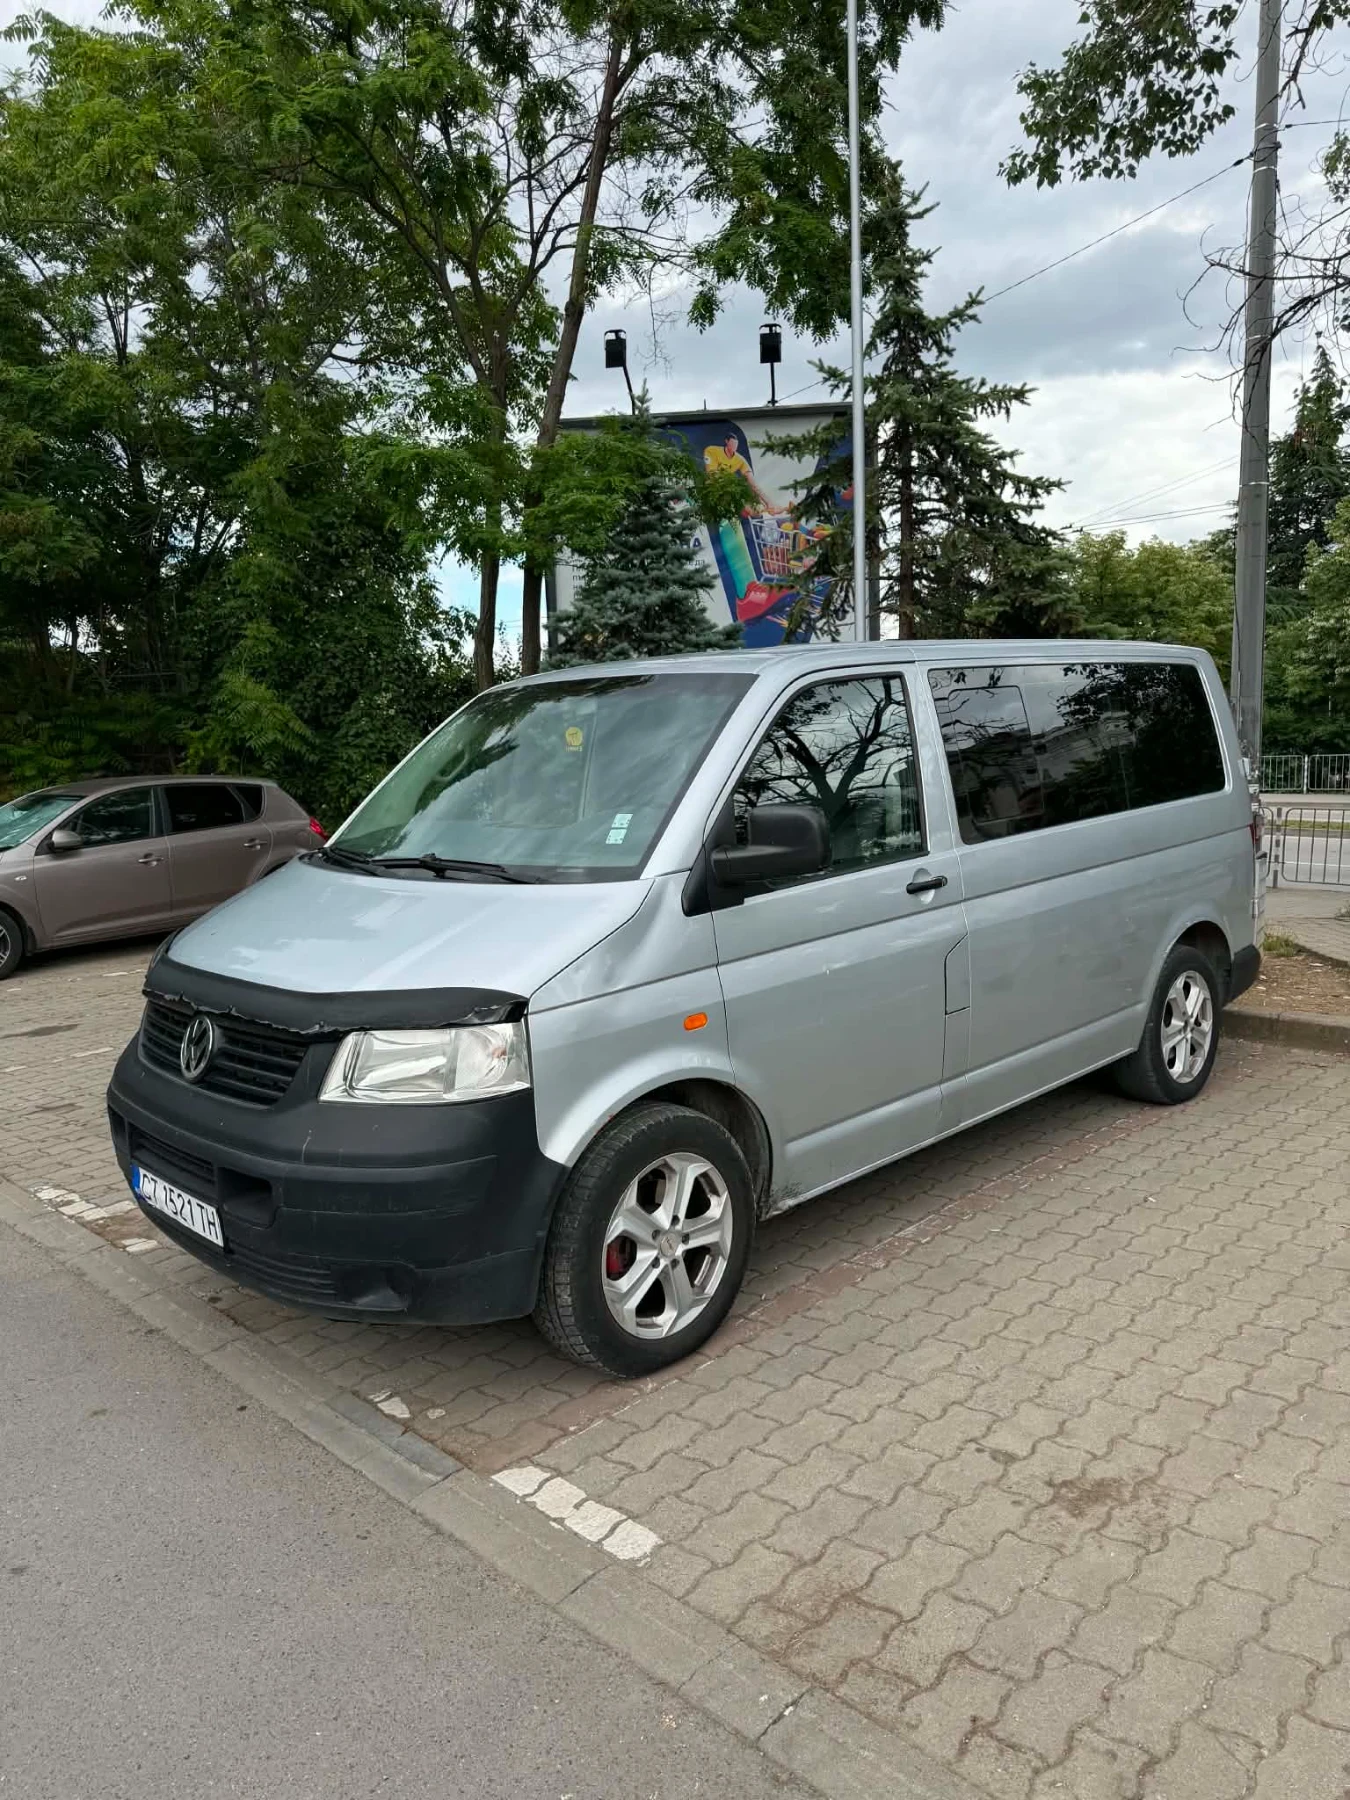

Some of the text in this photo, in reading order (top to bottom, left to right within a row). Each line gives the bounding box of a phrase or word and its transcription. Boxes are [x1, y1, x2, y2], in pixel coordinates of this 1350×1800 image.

[141, 1173, 219, 1240] CT 1521 TH
